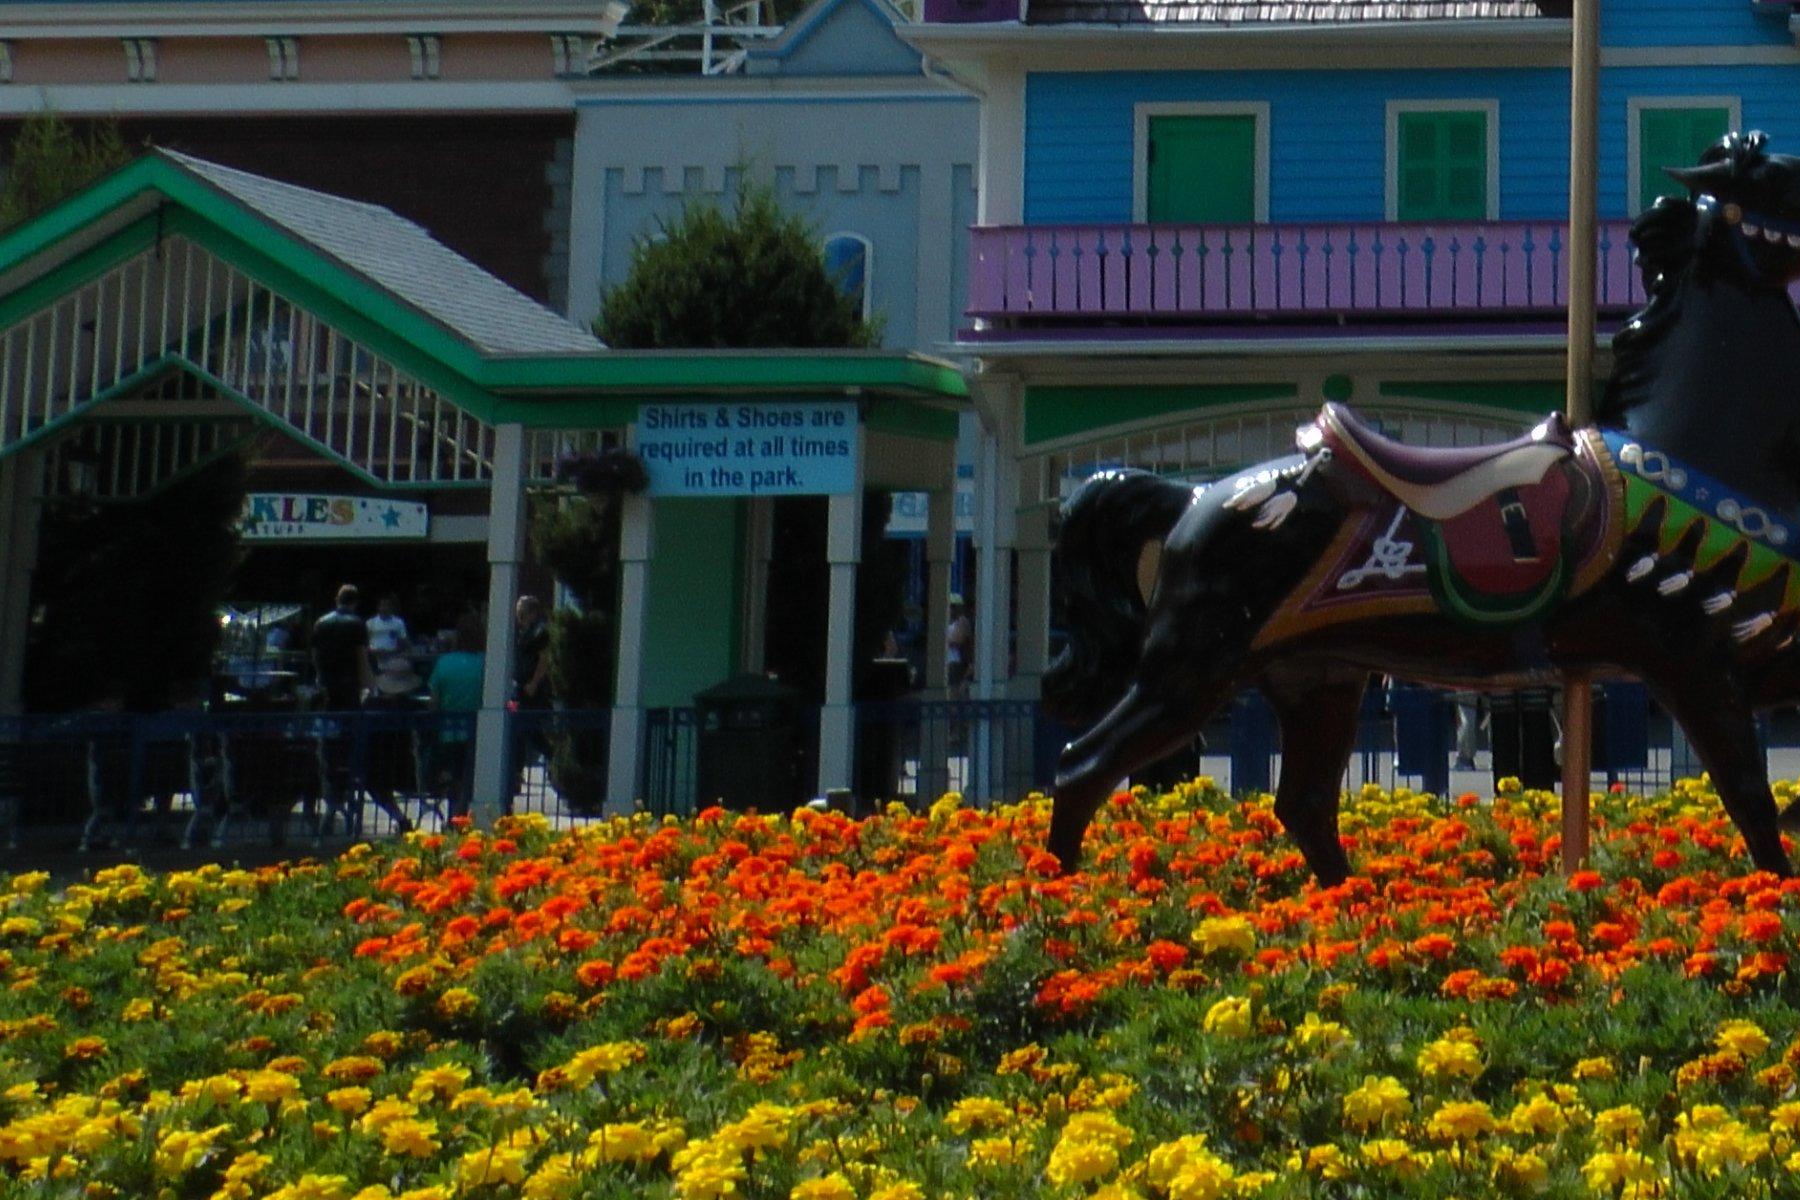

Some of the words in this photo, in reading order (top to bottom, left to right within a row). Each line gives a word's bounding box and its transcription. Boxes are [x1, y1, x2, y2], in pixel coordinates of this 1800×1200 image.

[645, 406, 708, 429] Shirts
[715, 406, 730, 428] &
[737, 405, 804, 428] Shoes
[811, 409, 845, 427] are
[639, 436, 728, 463] required
[734, 437, 755, 457] at
[760, 436, 784, 457] all
[791, 436, 849, 457] times
[684, 467, 703, 487] in
[710, 466, 744, 488] the
[750, 465, 802, 492] park.
[241, 496, 354, 525] KLES
